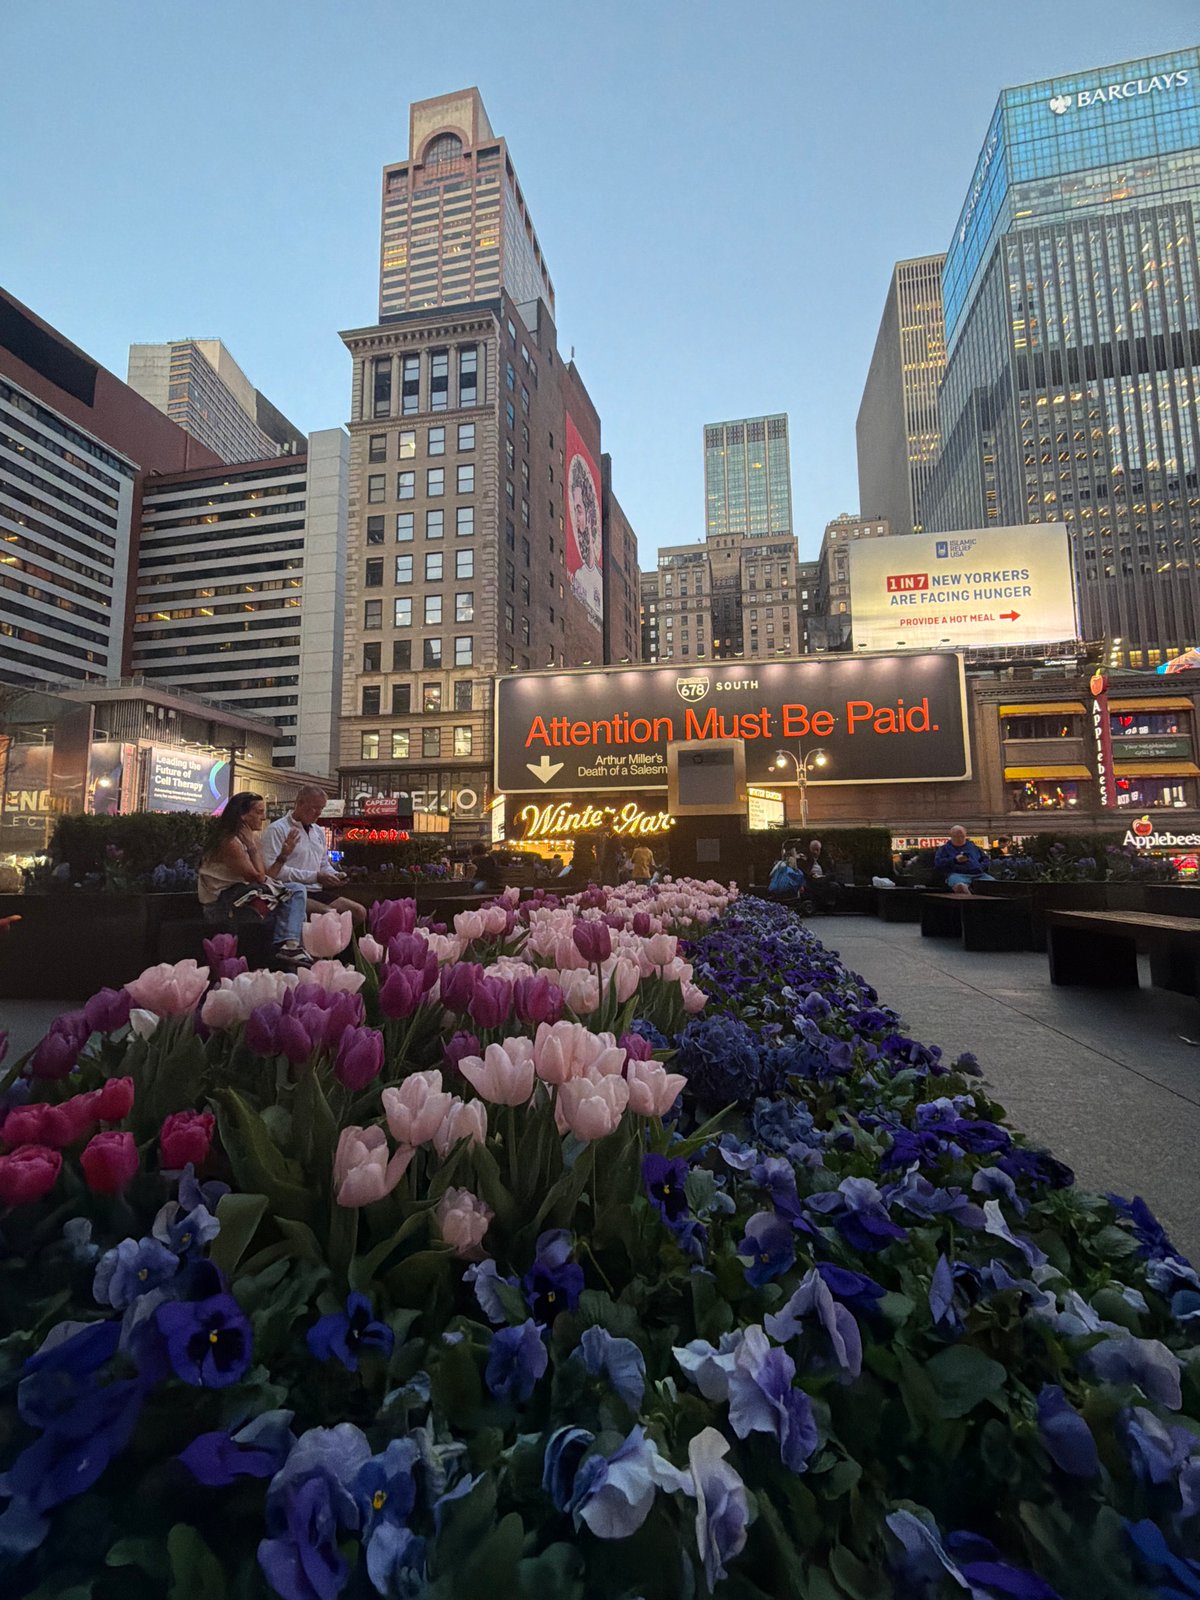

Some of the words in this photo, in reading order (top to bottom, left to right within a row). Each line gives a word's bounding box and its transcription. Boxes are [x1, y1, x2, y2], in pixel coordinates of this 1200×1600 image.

[1077, 69, 1189, 108] BARCLAYS
[889, 578, 898, 590] 1
[900, 576, 915, 589] IN
[916, 576, 926, 588] 7
[931, 573, 962, 587] NEW
[964, 568, 1030, 585] YORKERS
[890, 593, 917, 606] ARE
[920, 589, 970, 603] FACING
[973, 585, 1032, 600] HUNGER
[900, 617, 940, 627] PROVIDE
[941, 616, 949, 624] A
[949, 614, 968, 623] HOT
[969, 613, 996, 622] MEAL
[681, 684, 705, 696] 678
[715, 680, 759, 691] SOUTH
[524, 712, 674, 748] Attention
[684, 707, 773, 741] Must
[782, 703, 835, 738] Be
[847, 697, 939, 735] Paid.
[156, 755, 188, 770] Leading
[189, 761, 201, 771] the
[595, 754, 627, 766] Arthur
[628, 753, 664, 764] Miller's
[155, 765, 182, 777] Future
[182, 769, 192, 779] of
[577, 766, 608, 777] Death
[609, 765, 620, 776] of
[621, 767, 628, 775] a
[154, 774, 172, 786] Cell
[172, 777, 203, 792] Therapy
[614, 802, 676, 834] Gar
[1122, 830, 1200, 850] Applebee's
